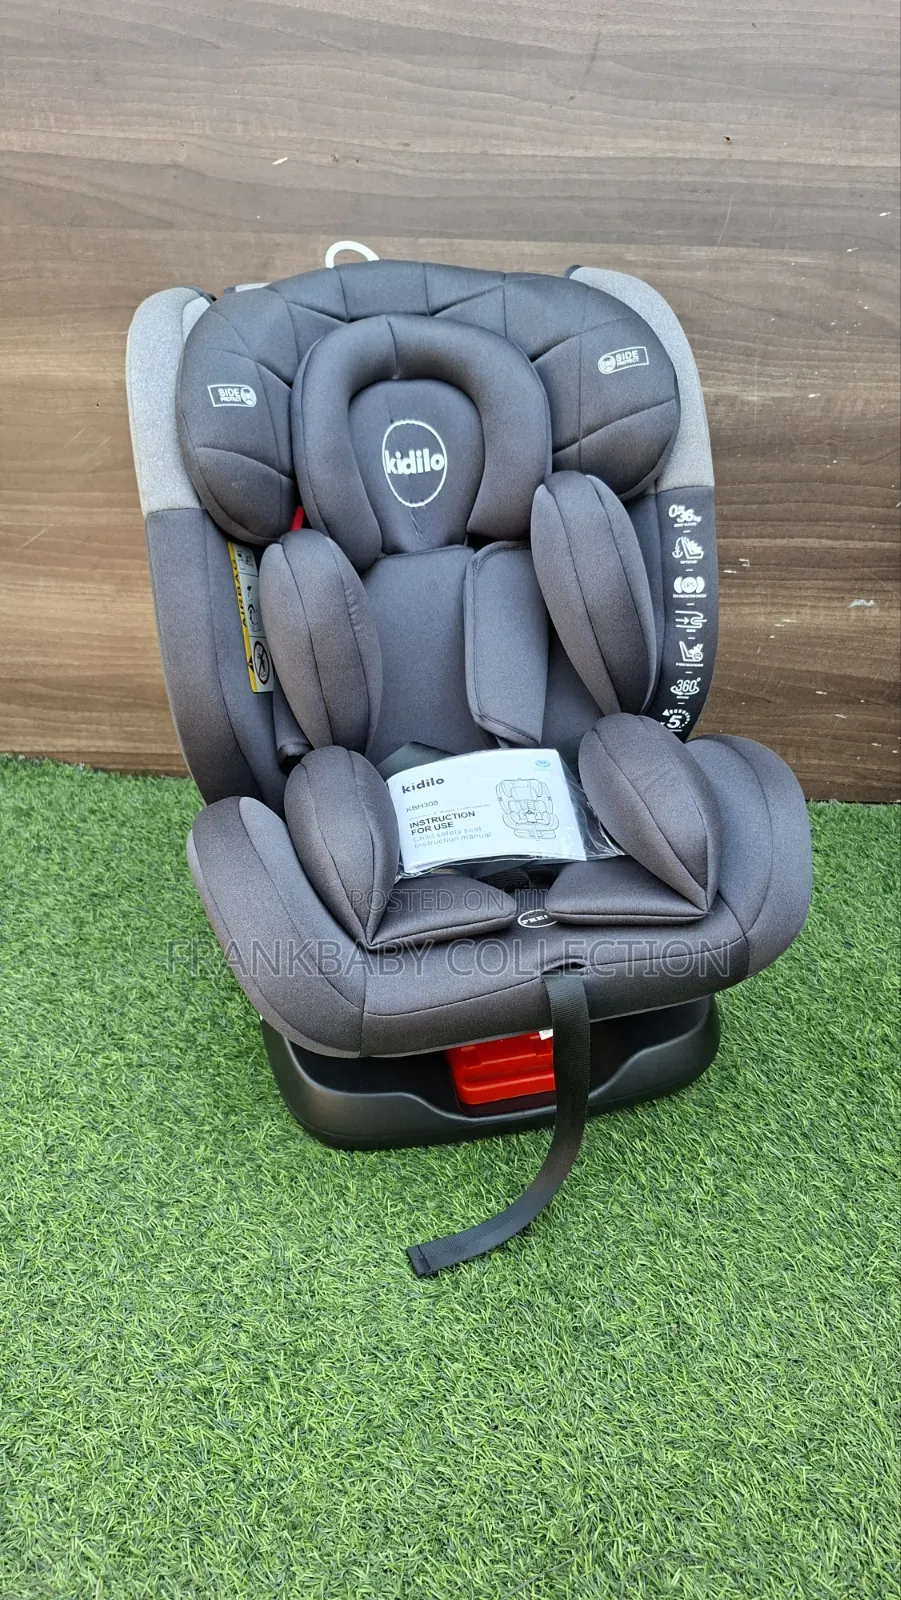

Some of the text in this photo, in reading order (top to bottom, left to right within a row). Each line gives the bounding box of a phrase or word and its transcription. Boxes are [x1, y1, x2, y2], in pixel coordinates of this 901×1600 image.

[615, 350, 639, 361] SIDE
[218, 388, 240, 397] SIDE
[384, 448, 445, 475] kidilo
[401, 777, 445, 794] kidilo
[406, 800, 439, 812] KBH308
[409, 810, 476, 829] INSTRUCTION
[411, 821, 455, 836] FOR USE
[413, 826, 483, 843] Child safety seat
[460, 832, 492, 841] manual
